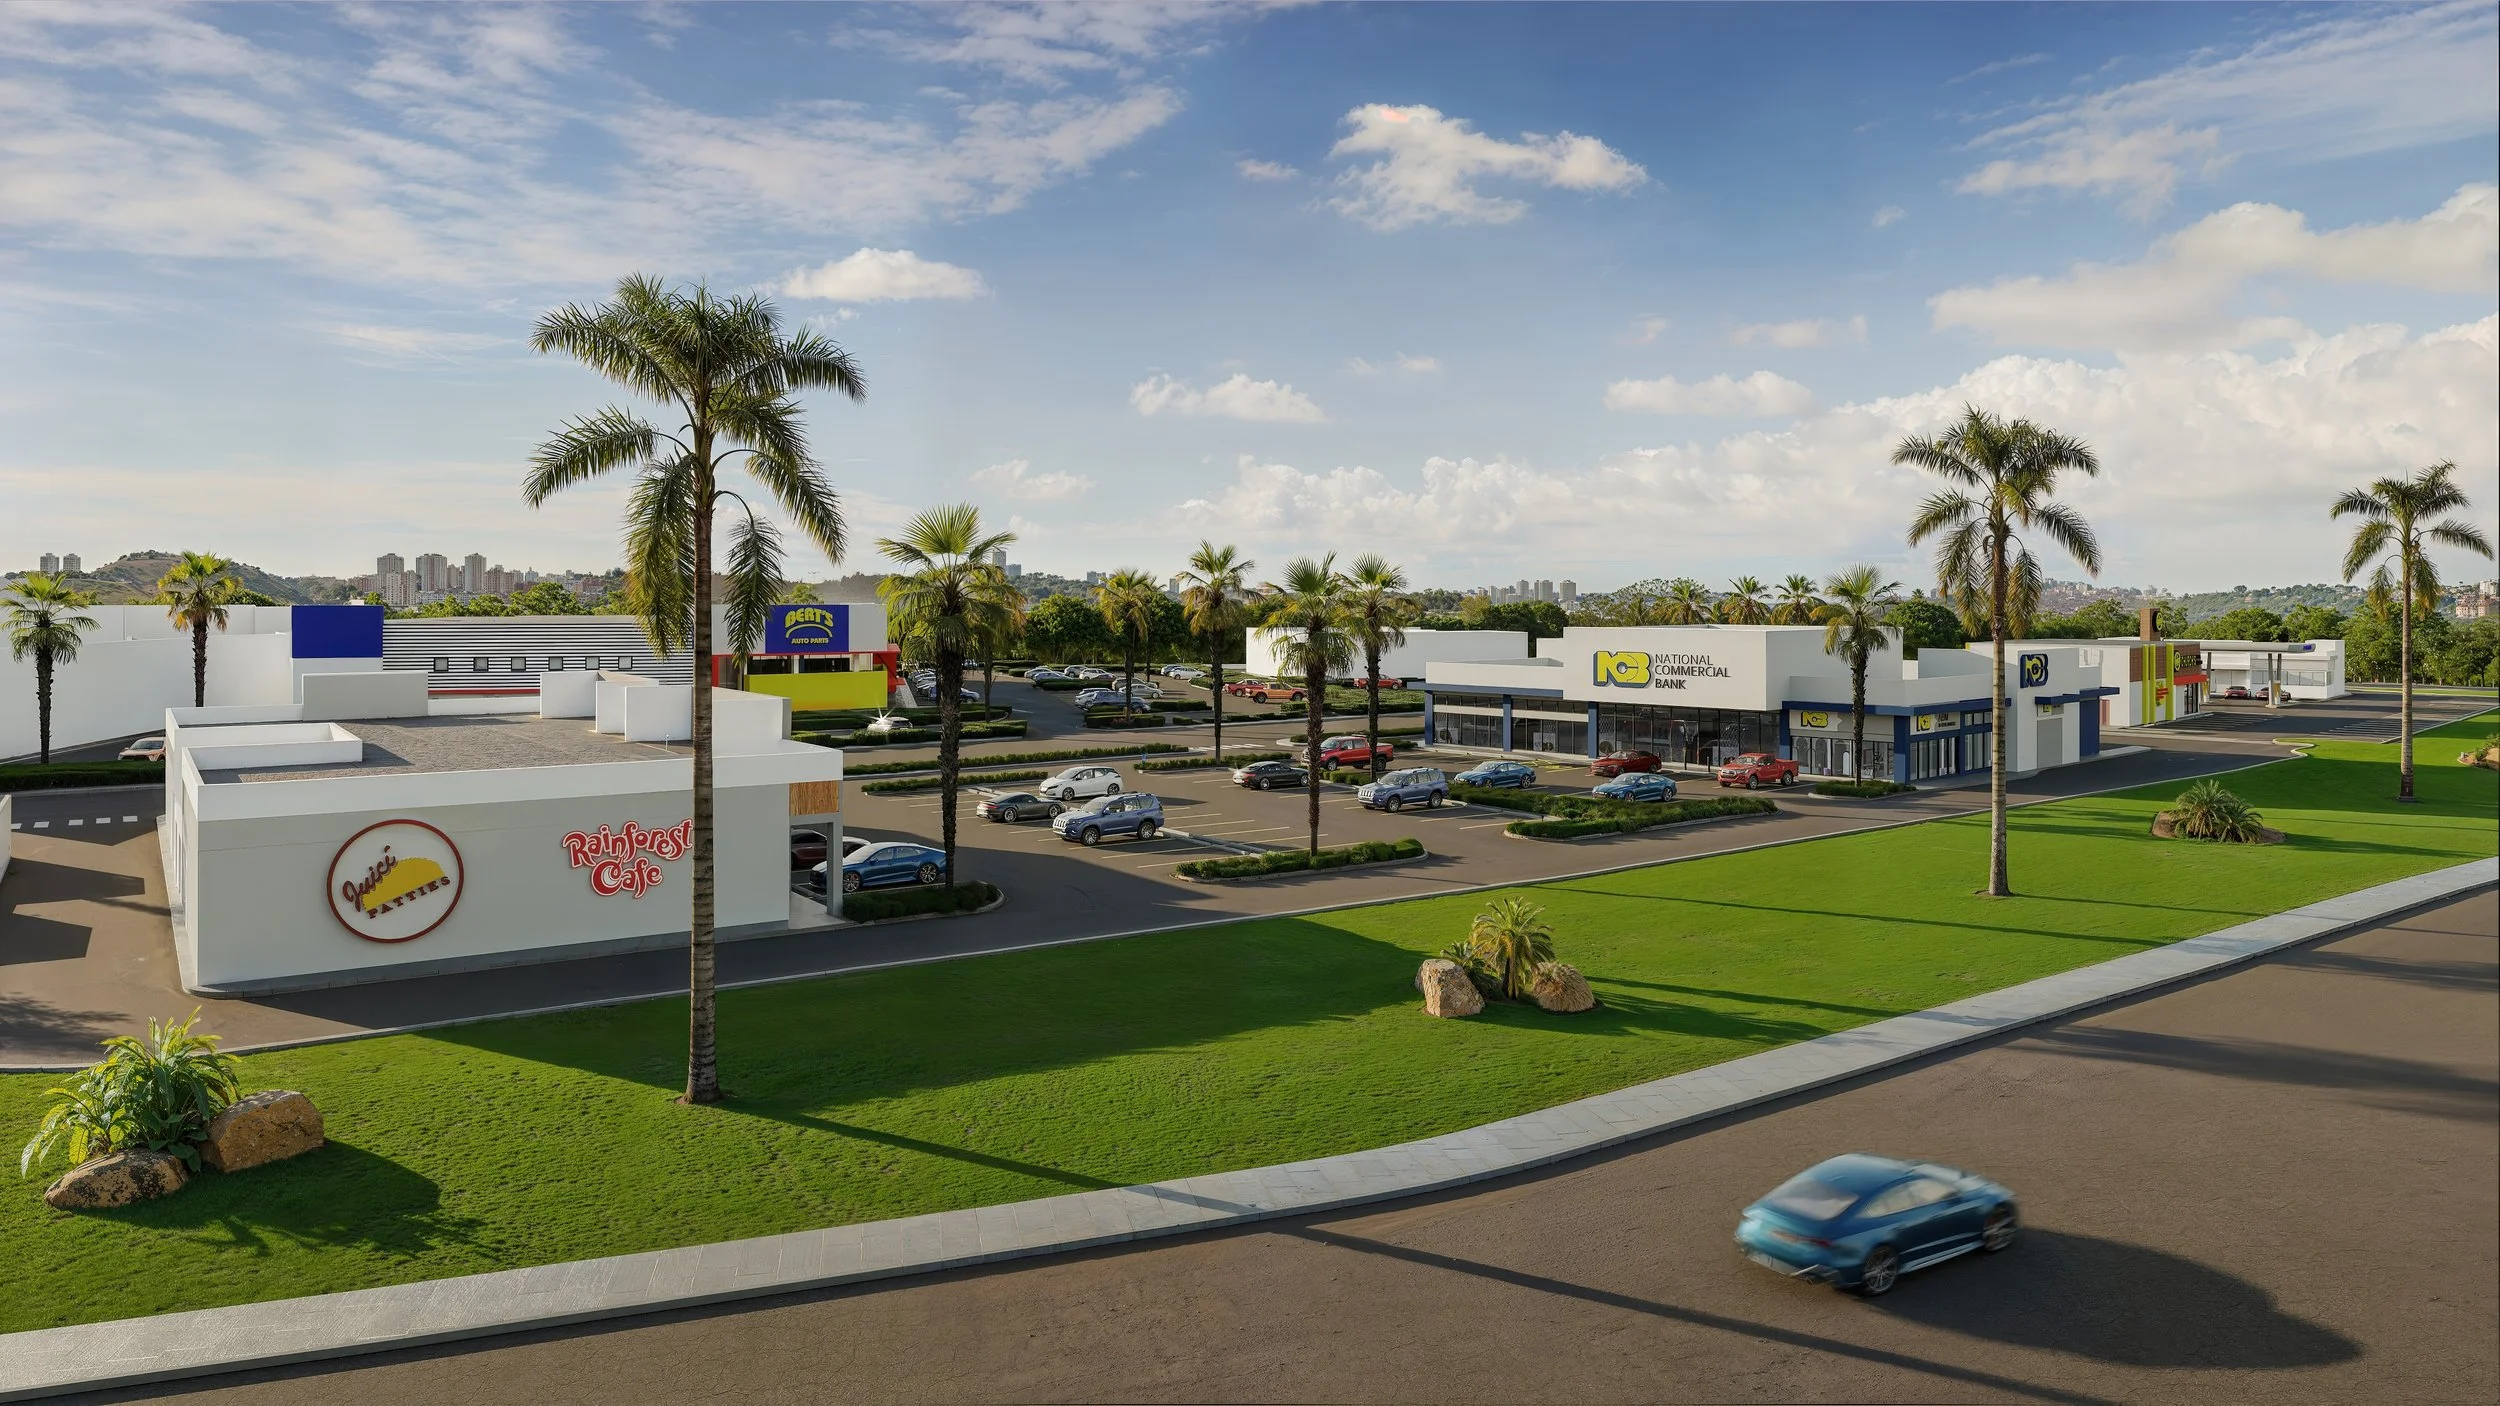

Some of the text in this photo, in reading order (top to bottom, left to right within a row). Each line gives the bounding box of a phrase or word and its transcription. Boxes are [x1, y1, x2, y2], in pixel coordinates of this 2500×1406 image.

[785, 607, 834, 628] BERT'S
[1593, 651, 1651, 688] NCB
[1655, 654, 1713, 666] NATIONAL
[1655, 666, 1731, 678] COMMERCIAL
[1655, 679, 1687, 689] BANK
[1801, 711, 1828, 728] NCB
[562, 818, 694, 868] Rainforest
[591, 857, 663, 898] Cafe
[366, 876, 451, 919] PATTIES
